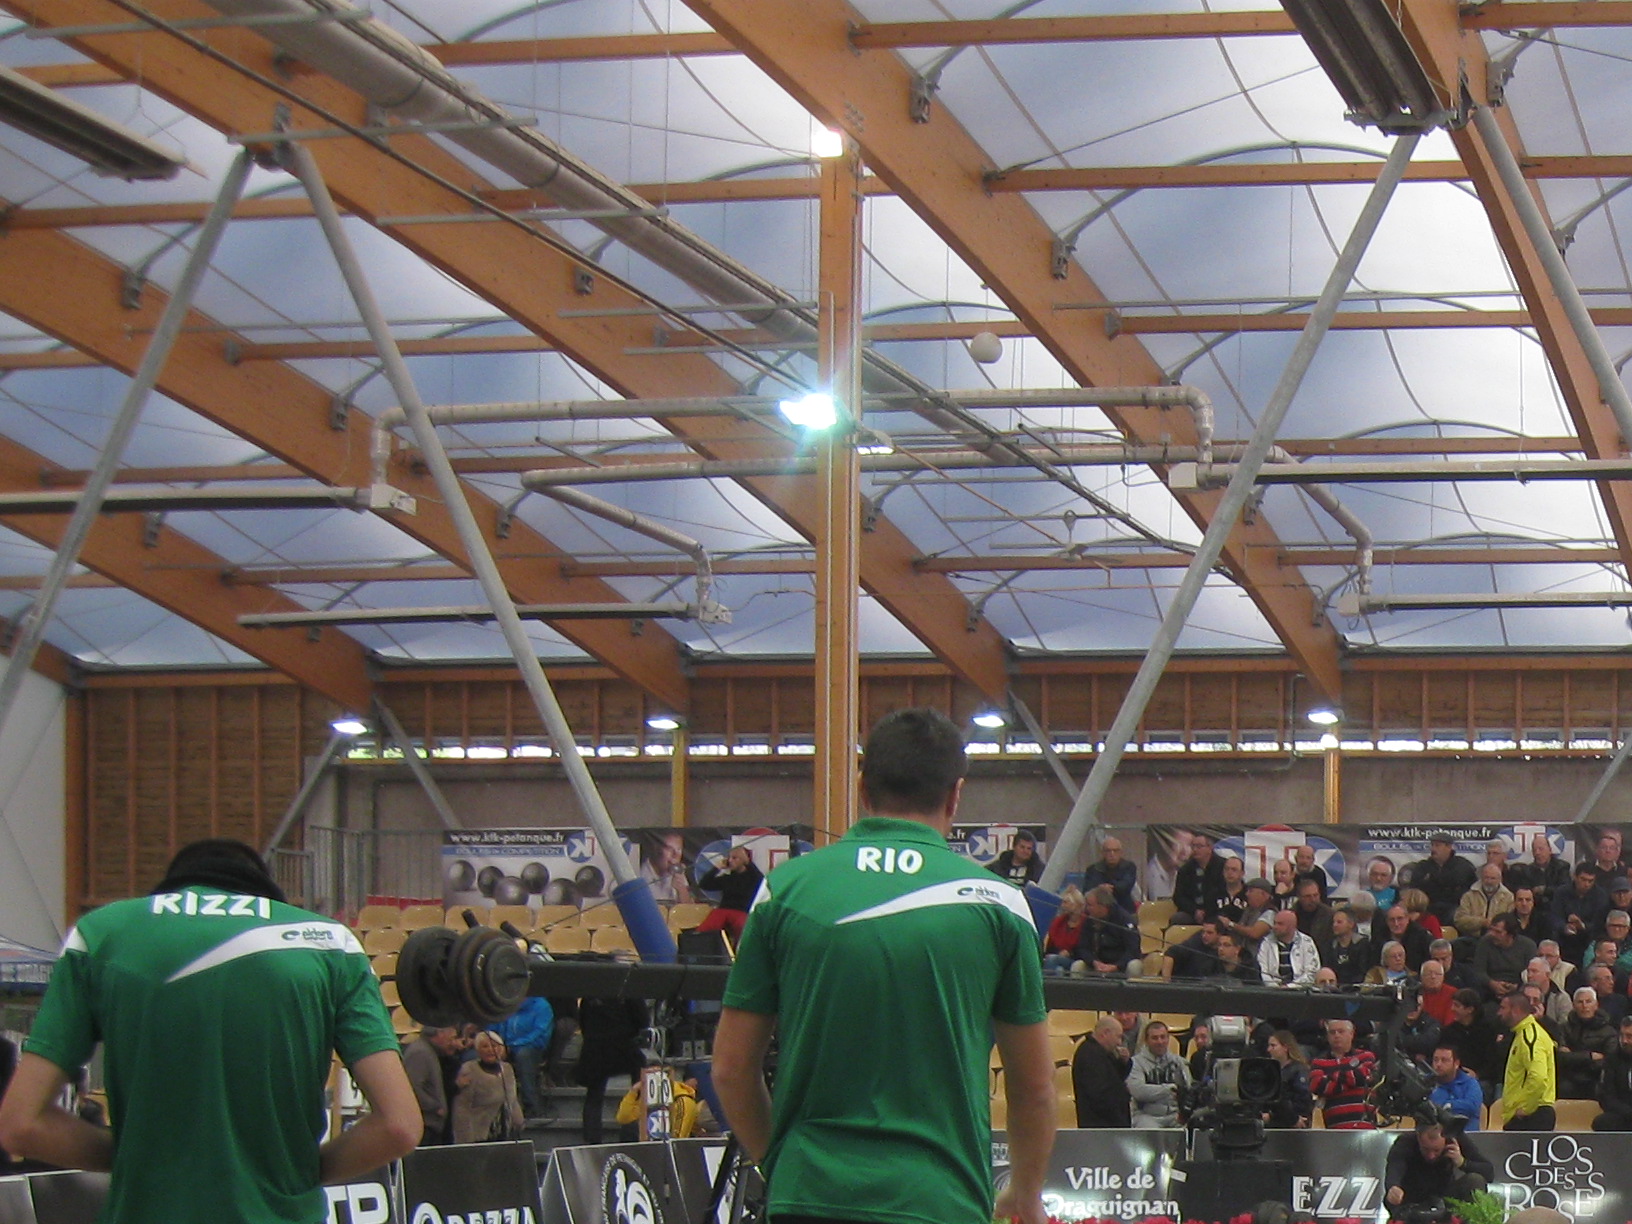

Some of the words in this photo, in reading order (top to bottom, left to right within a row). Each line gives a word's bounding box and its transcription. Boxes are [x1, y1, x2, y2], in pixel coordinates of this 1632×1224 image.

[1367, 826, 1492, 839] www.ktk-ptnque.fr
[856, 846, 924, 874] RIO
[152, 890, 272, 919] RIZZI
[1505, 1135, 1594, 1180] CLOS
[1064, 1167, 1122, 1191] Ville
[1126, 1166, 1156, 1190] de
[1535, 1167, 1576, 1190] DES
[1042, 1193, 1180, 1220] Draguignan
[1291, 1176, 1380, 1219] EZZ
